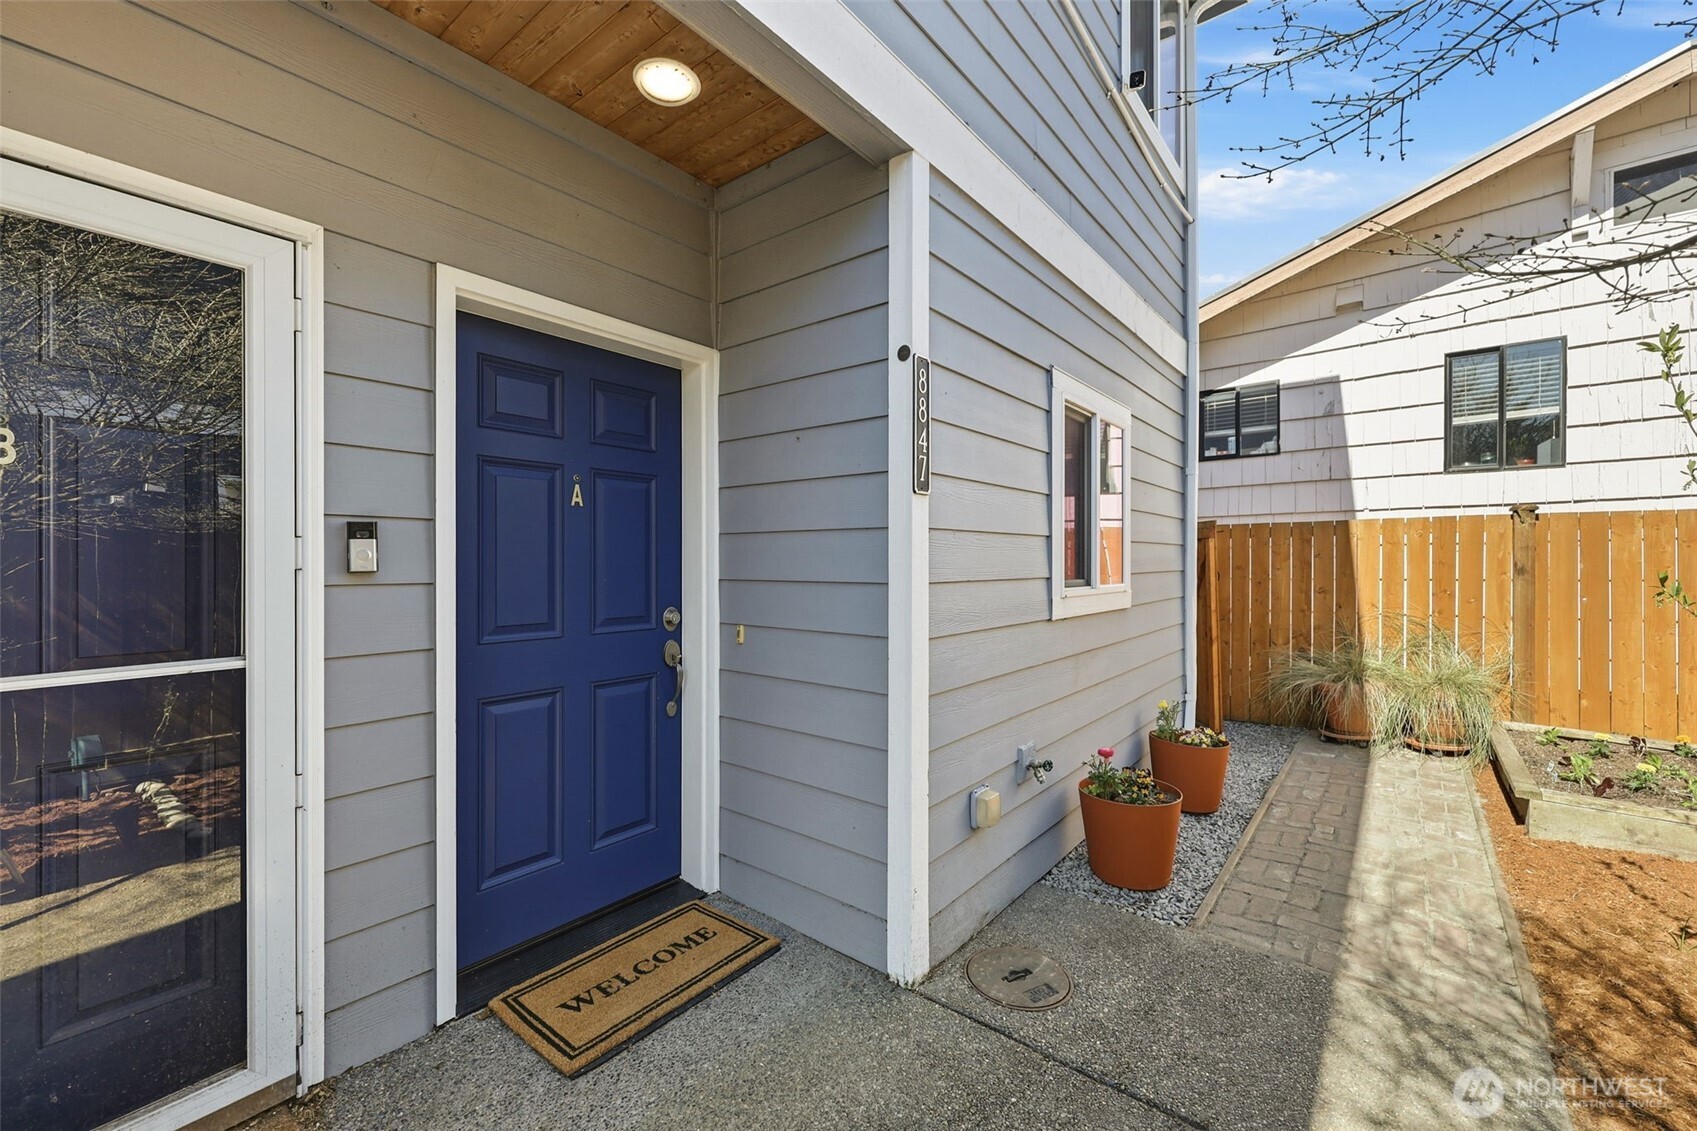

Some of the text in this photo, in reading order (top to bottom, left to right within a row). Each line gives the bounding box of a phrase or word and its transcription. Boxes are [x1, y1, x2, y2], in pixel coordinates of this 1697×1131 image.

[0, 428, 17, 465] B
[918, 368, 928, 482] 8847
[571, 484, 584, 507] A
[555, 926, 718, 1013] WELCOME
